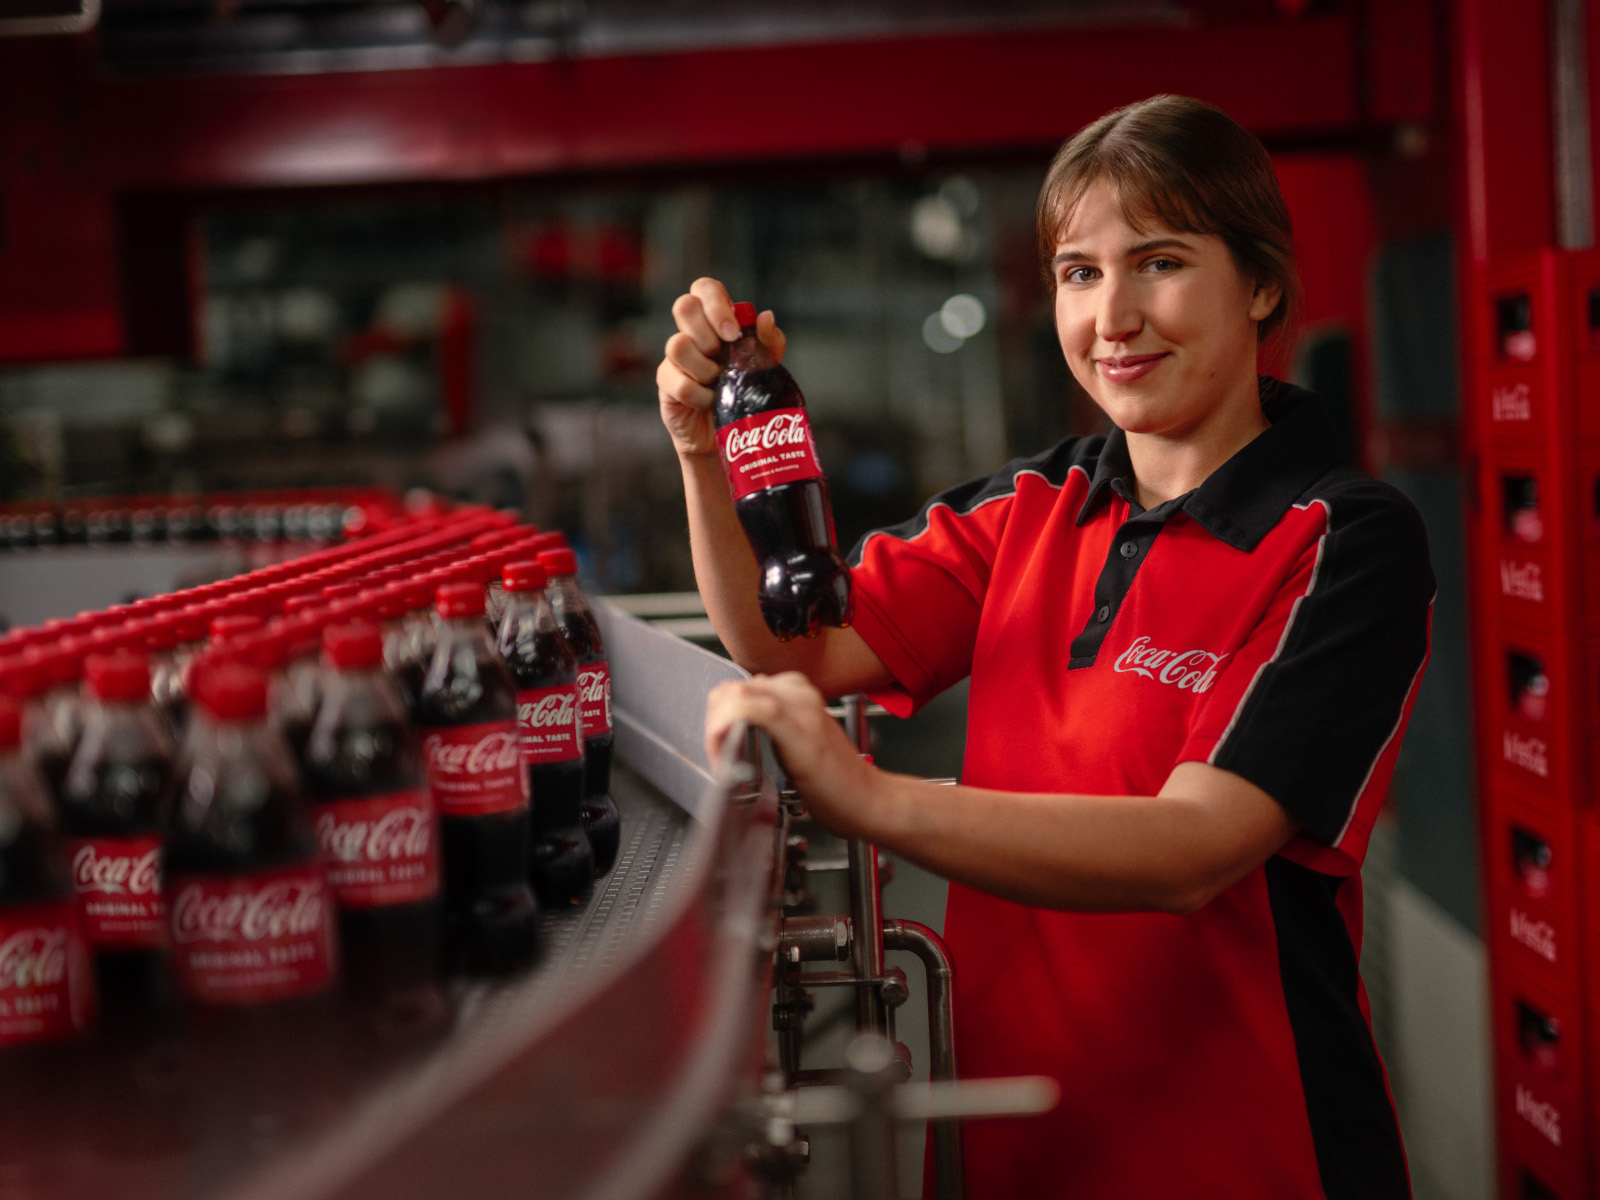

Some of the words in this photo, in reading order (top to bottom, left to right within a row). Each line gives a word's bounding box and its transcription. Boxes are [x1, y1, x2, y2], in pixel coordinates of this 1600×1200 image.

[725, 413, 806, 462] Coca-Cola
[739, 456, 779, 473] ORIGINAL
[779, 450, 806, 461] TASTE
[545, 733, 571, 742] TASTE
